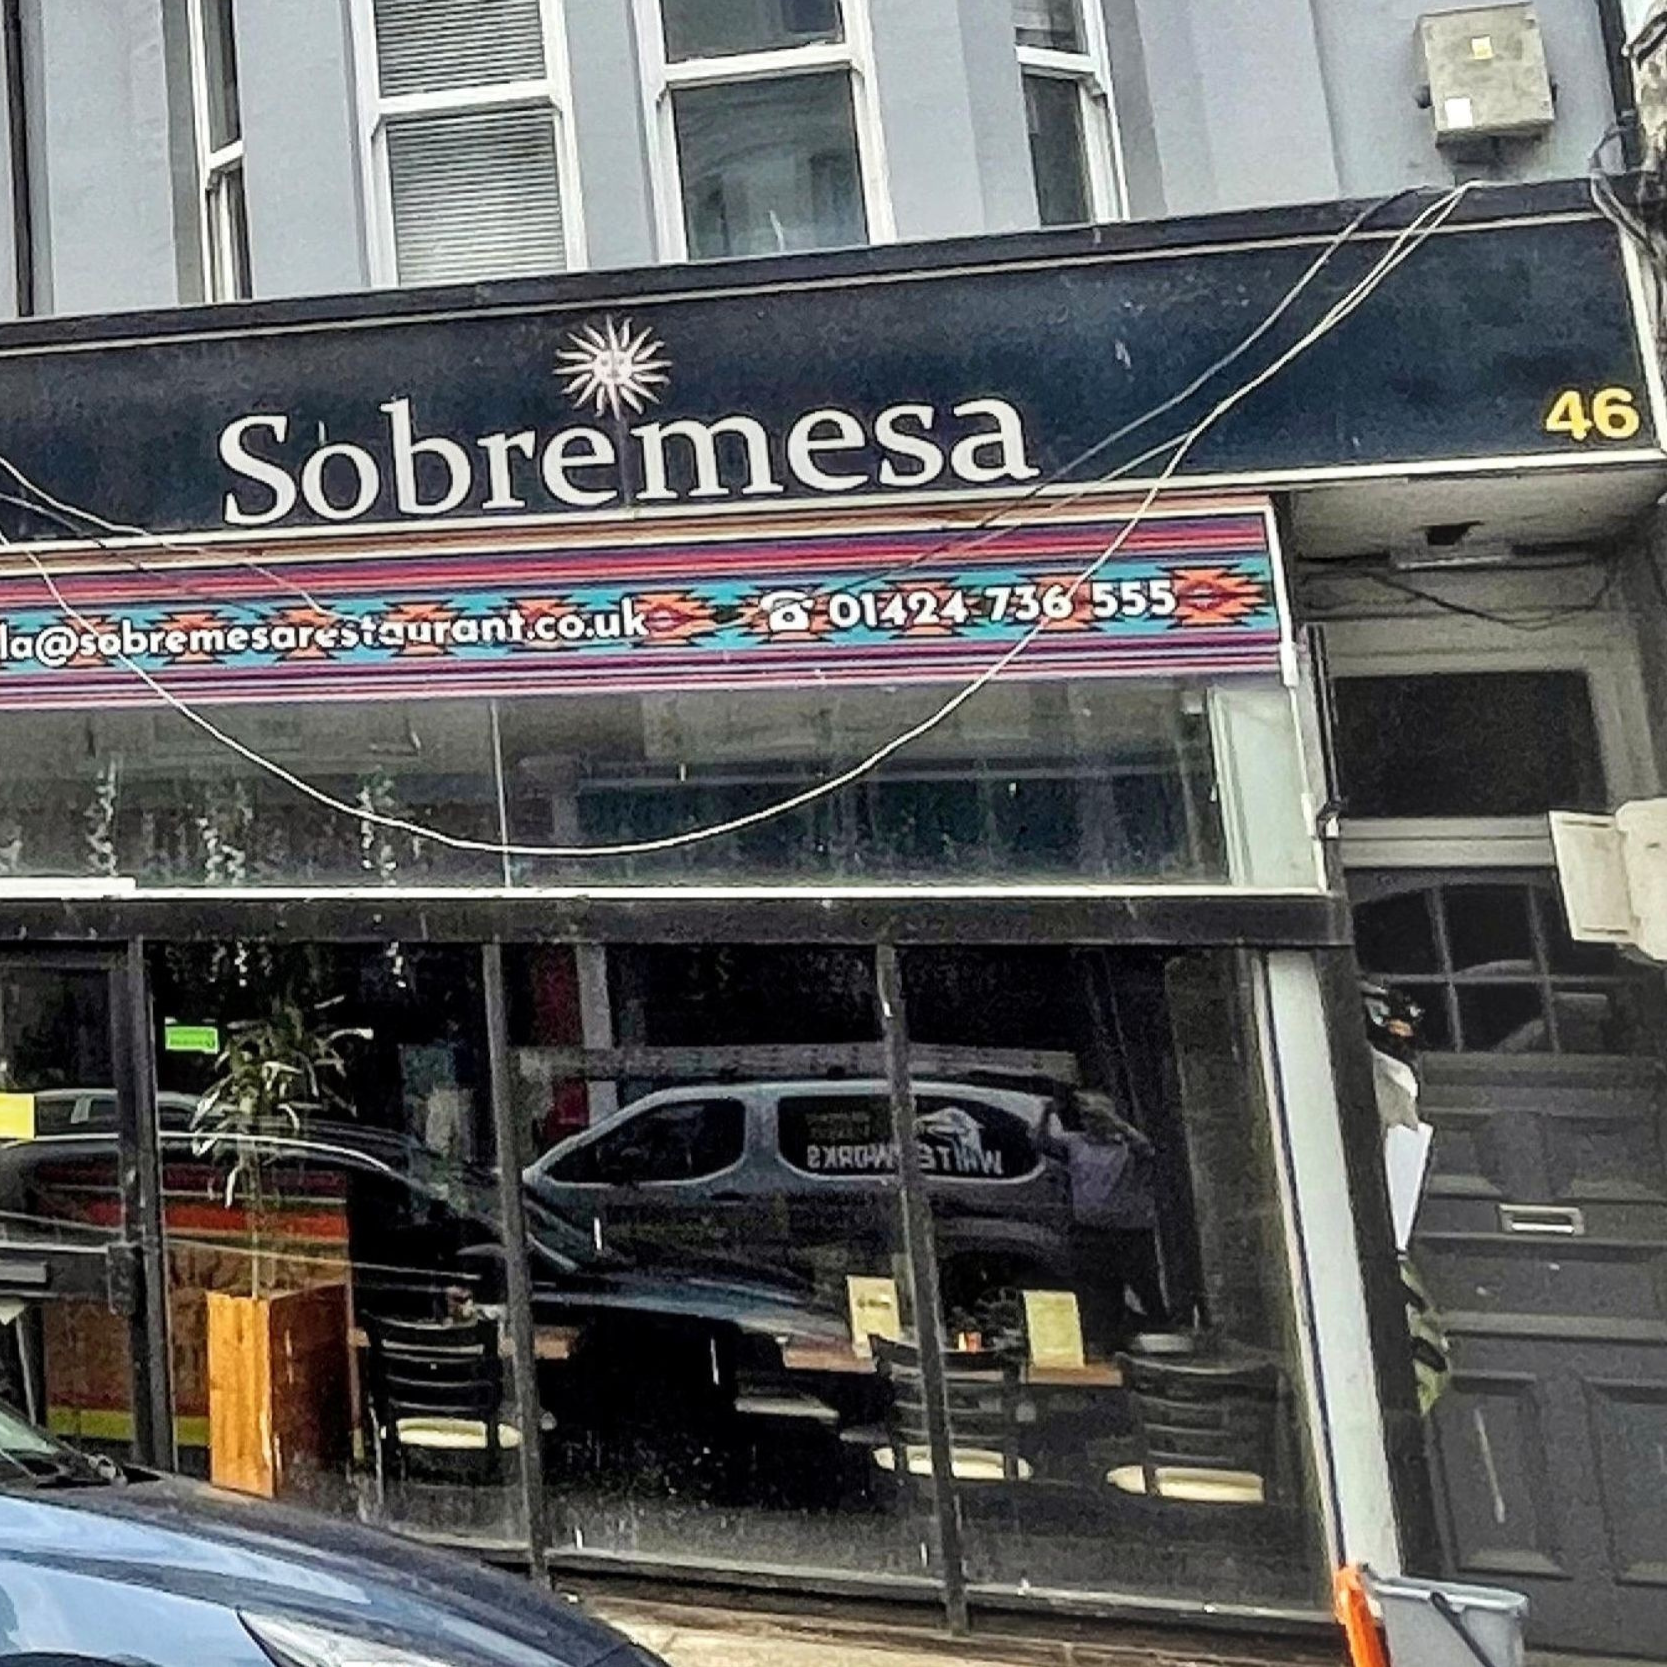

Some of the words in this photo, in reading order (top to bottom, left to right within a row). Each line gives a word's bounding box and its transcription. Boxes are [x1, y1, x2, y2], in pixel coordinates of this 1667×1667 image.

[1545, 387, 1640, 441] 46
[219, 395, 1041, 526] Sobremesa
[828, 590, 968, 628] 01424
[985, 585, 1072, 622] 736
[1091, 580, 1177, 618] 555
